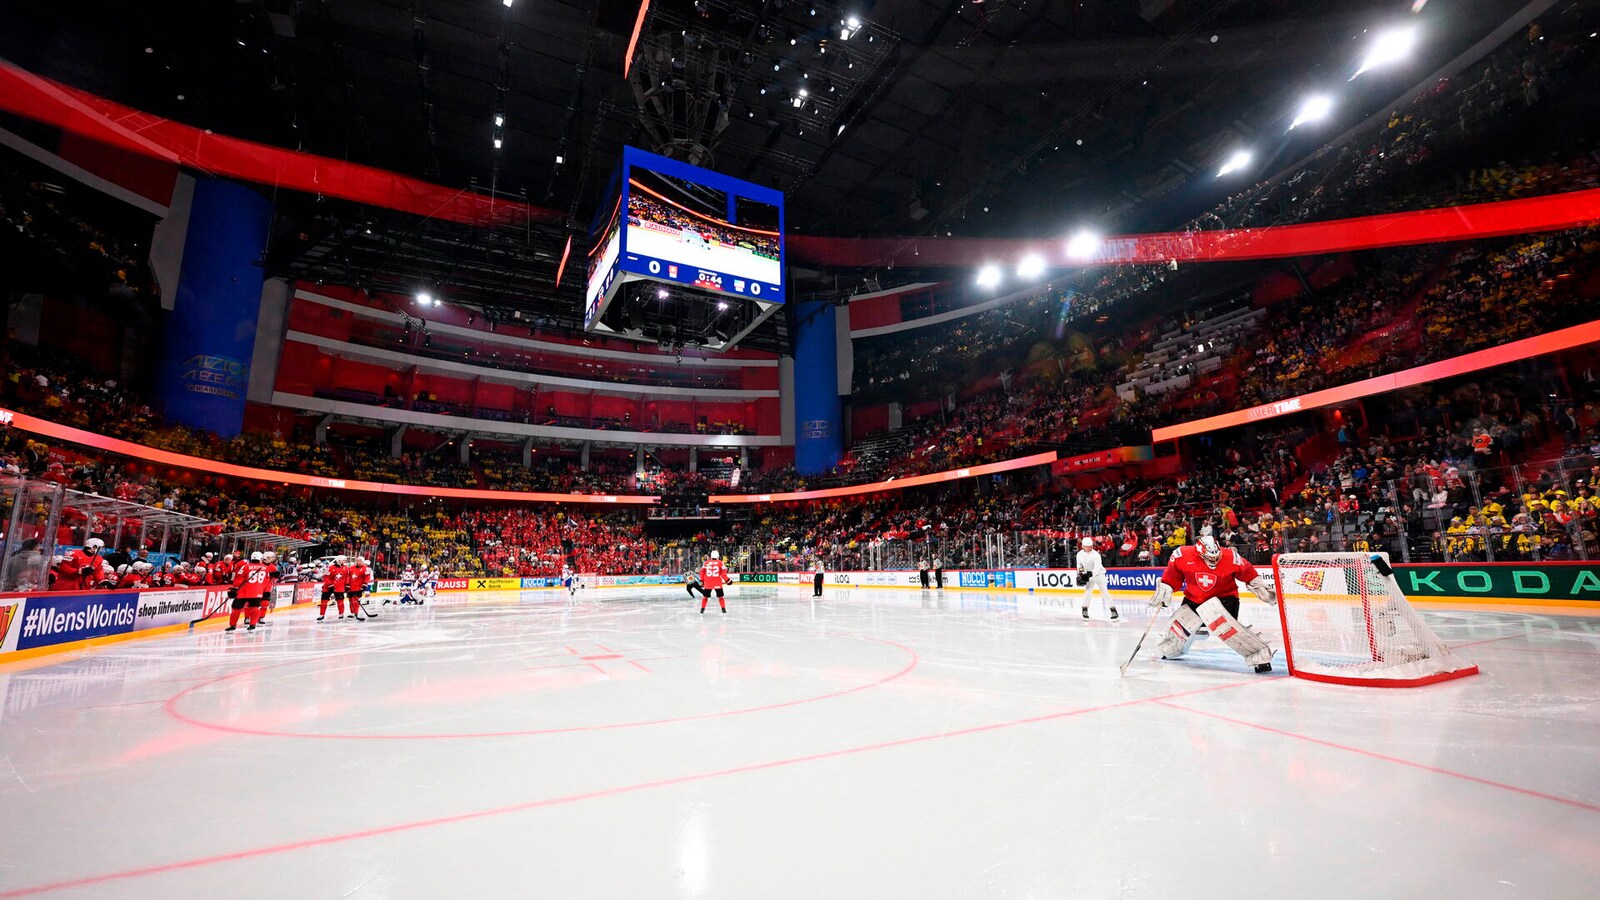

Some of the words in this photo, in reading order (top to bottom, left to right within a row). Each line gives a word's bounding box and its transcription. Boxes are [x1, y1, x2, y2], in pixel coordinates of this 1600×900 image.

[649, 260, 661, 274] 0
[698, 273, 722, 285] 0:44
[750, 282, 761, 295] 0
[1247, 398, 1302, 420] OVERTIME
[706, 566, 720, 577] 62
[962, 572, 986, 584] NOCCO
[523, 578, 545, 587] NOCCO
[1036, 572, 1073, 587] iLOQ
[138, 600, 204, 618] shop.iihfworlds.com
[23, 602, 135, 638] #MensWorlds
